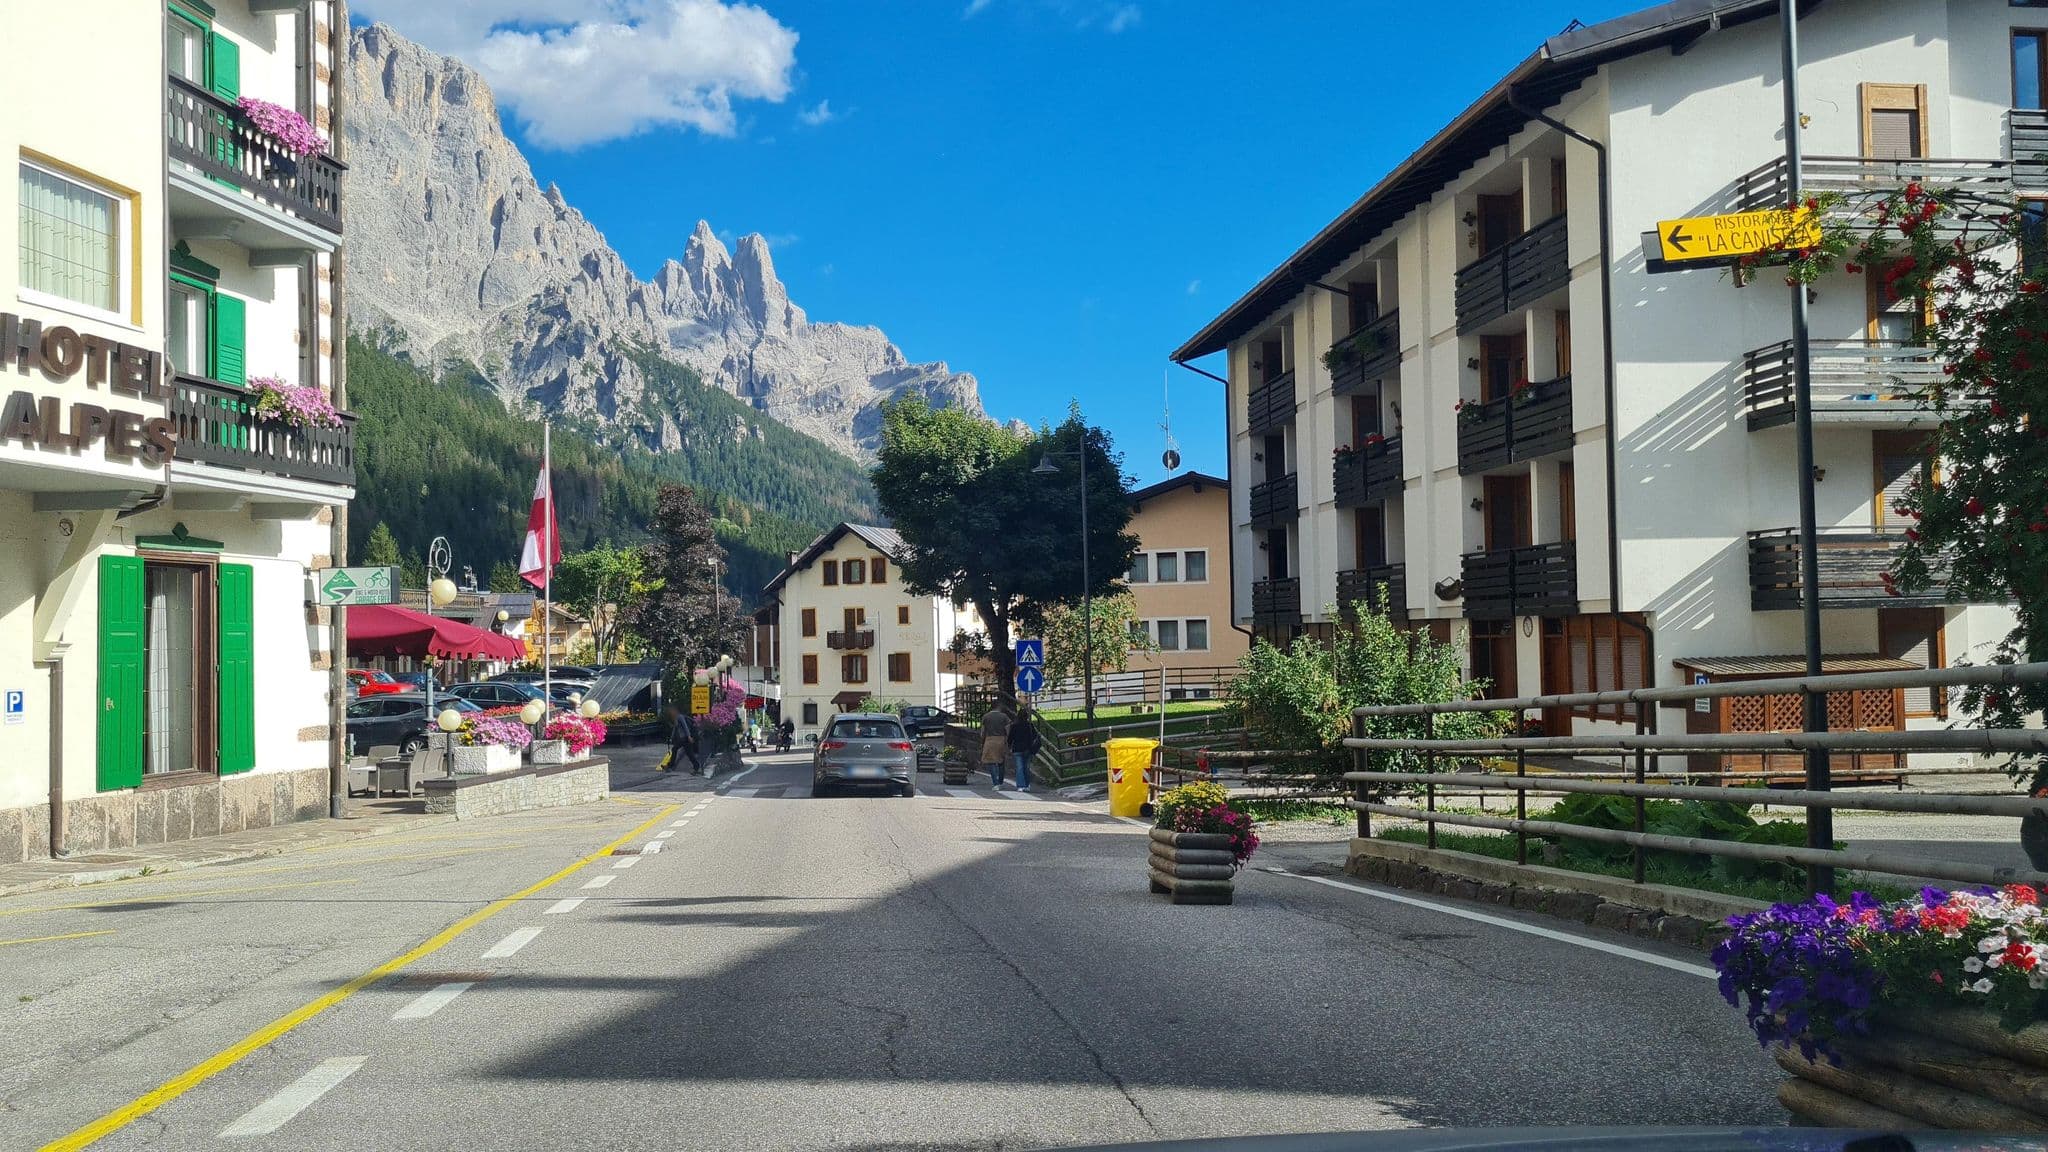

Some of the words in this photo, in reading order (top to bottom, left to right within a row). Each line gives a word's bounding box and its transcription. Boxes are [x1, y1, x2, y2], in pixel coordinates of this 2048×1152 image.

[1714, 210, 1793, 230] RISTORAN
[1731, 225, 1813, 250] CANISA
[0, 312, 175, 402] HOTEL
[2, 391, 176, 464] ALPES
[9, 692, 20, 711] P
